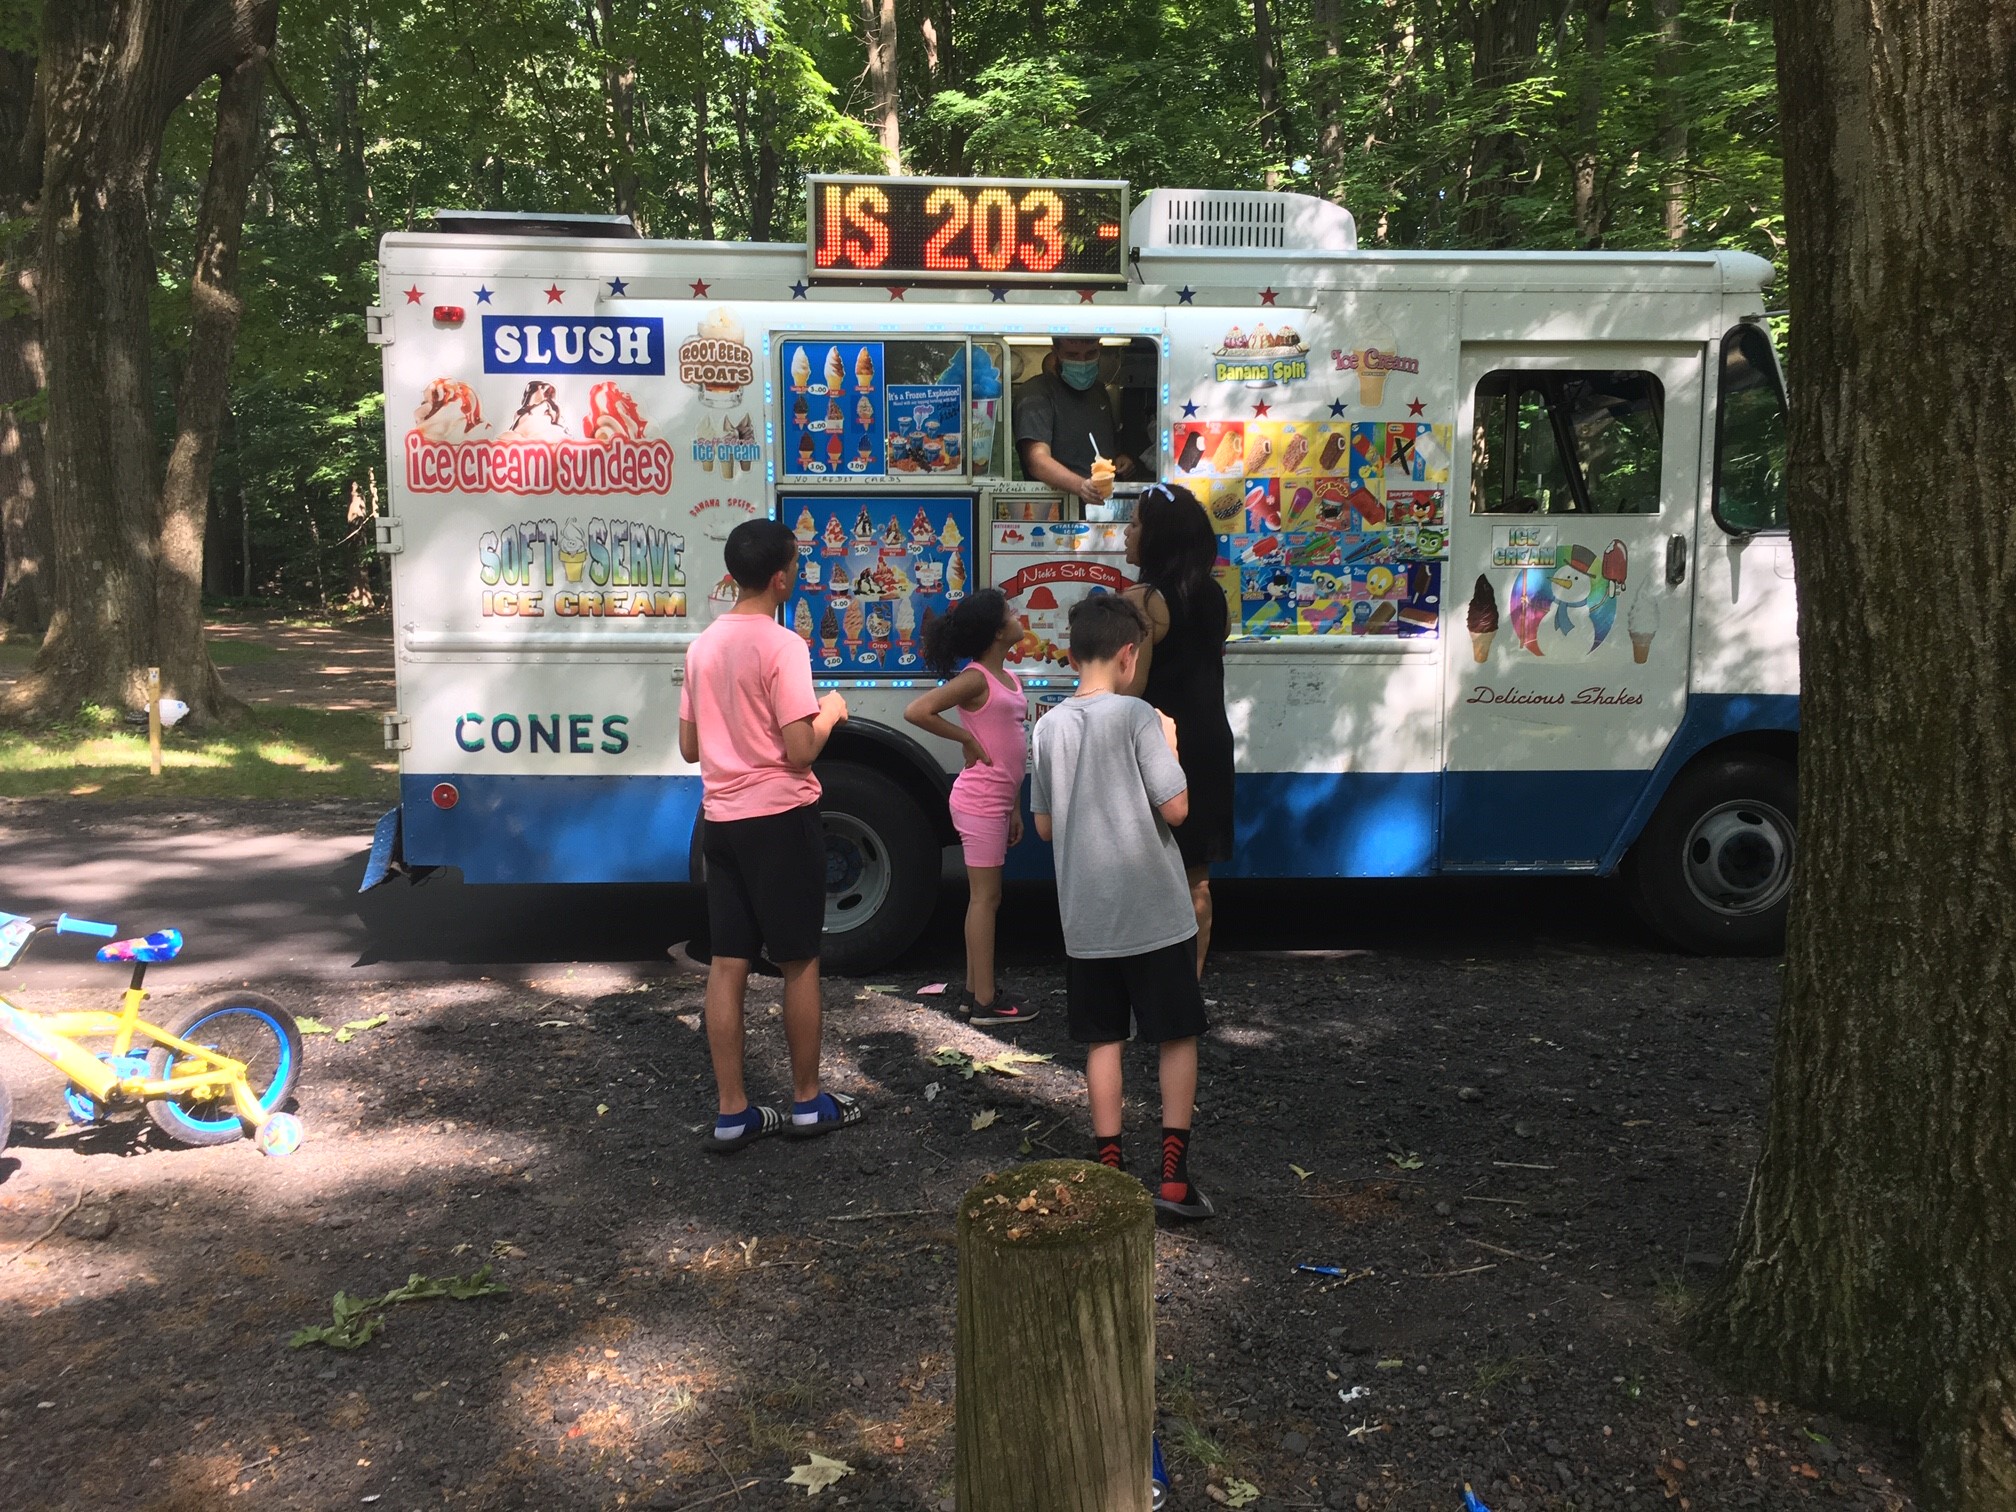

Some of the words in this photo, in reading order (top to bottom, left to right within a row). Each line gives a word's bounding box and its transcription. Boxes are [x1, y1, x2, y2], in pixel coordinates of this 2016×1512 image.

[925, 188, 1063, 271] 203
[494, 325, 652, 365] SLUSH
[682, 341, 716, 363] ROOT
[718, 340, 750, 365] BEER
[1216, 362, 1269, 382] Banana
[1272, 360, 1307, 383] Split
[1331, 350, 1359, 371] Ice
[1363, 347, 1420, 374] Cream
[683, 366, 750, 382] FLOATS
[905, 391, 927, 399] Frozen
[928, 388, 960, 401] Explosion!
[693, 439, 713, 461] ice
[717, 444, 760, 461] cream
[410, 435, 456, 487] ice
[459, 447, 552, 488] cream
[559, 440, 673, 491] sundaes
[689, 499, 720, 517] BANANA
[1508, 527, 1541, 546] ICE
[479, 518, 559, 587] SOFT
[587, 517, 687, 588] SERVE
[1492, 547, 1555, 566] CREAM
[1023, 568, 1057, 583] Nick's
[1060, 564, 1086, 577] Soft
[481, 590, 544, 617] ICE
[554, 590, 688, 617] CREAM
[1466, 685, 1566, 705] Delicious
[1570, 686, 1644, 705] Shakes
[454, 712, 630, 755] CONES
